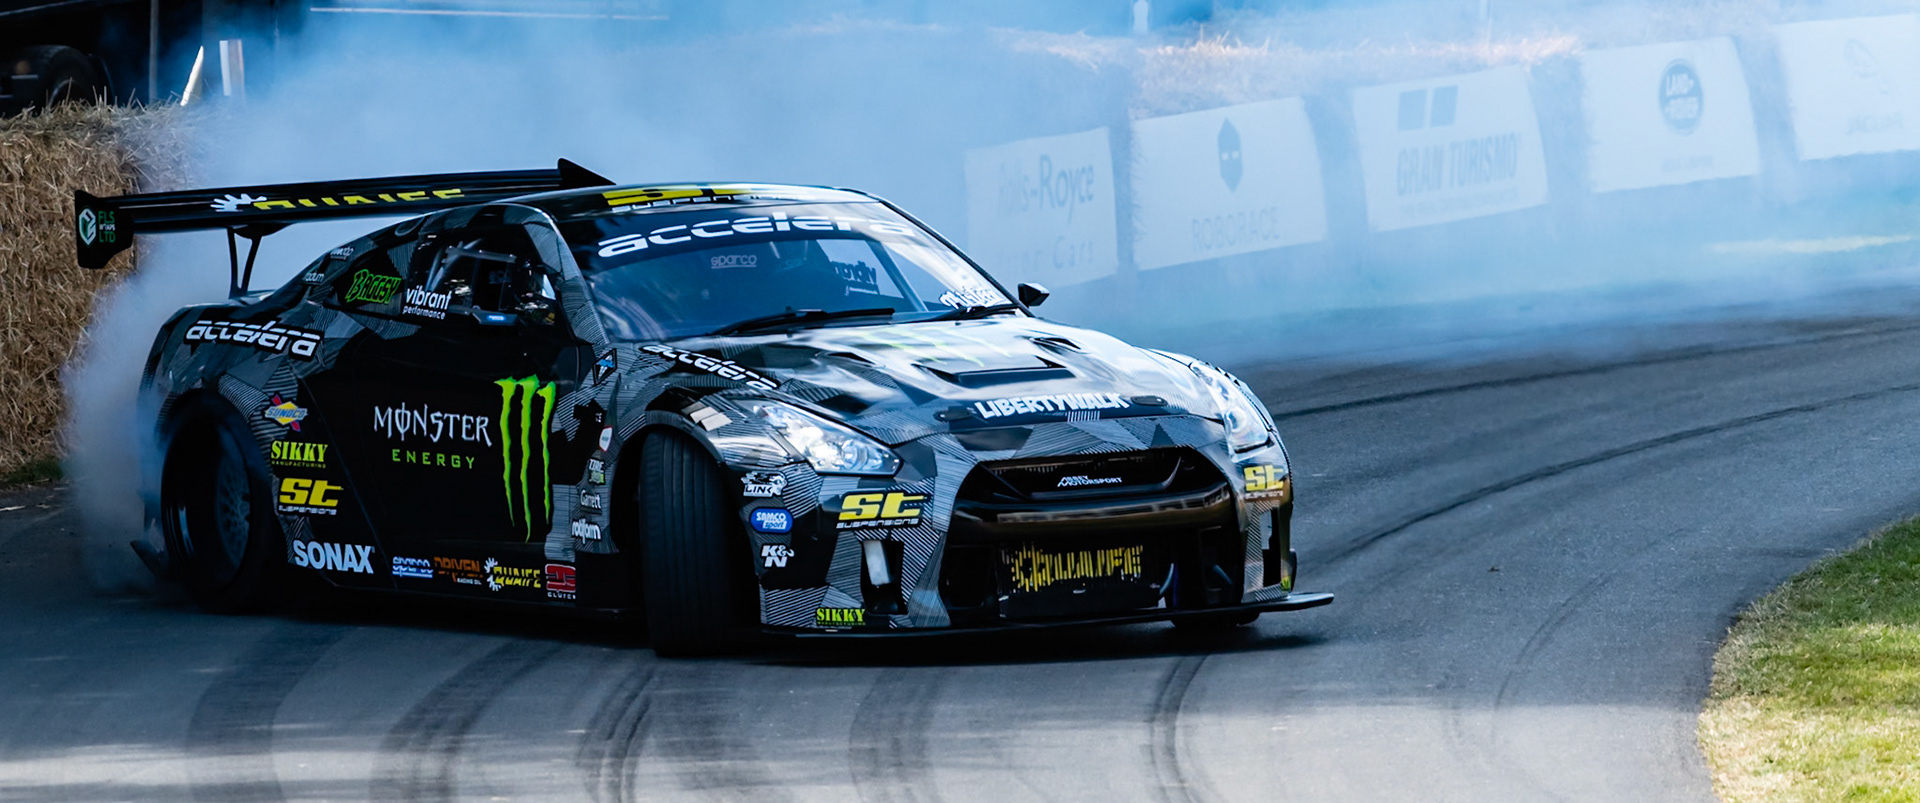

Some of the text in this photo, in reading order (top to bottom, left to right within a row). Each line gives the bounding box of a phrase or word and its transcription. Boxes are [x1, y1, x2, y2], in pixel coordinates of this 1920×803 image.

[1396, 132, 1518, 196] GRAN TURISMO
[98, 210, 116, 225] FLS
[98, 231, 116, 243] LTD
[598, 212, 915, 258] accelera
[1191, 206, 1280, 252] ROBORACE
[711, 254, 757, 267] sparco
[1053, 235, 1094, 269] Cars
[405, 285, 453, 310] vibrant
[402, 304, 447, 320] performance
[186, 320, 321, 357] accelera
[643, 344, 778, 391] accelera
[266, 407, 306, 419] SUNOCO
[271, 440, 328, 463] SIKKY
[392, 449, 475, 469] ENERGY
[756, 512, 786, 522] SAMCO
[764, 521, 786, 529] sport
[293, 539, 375, 574] SONAX
[816, 607, 866, 622] SIKKY
